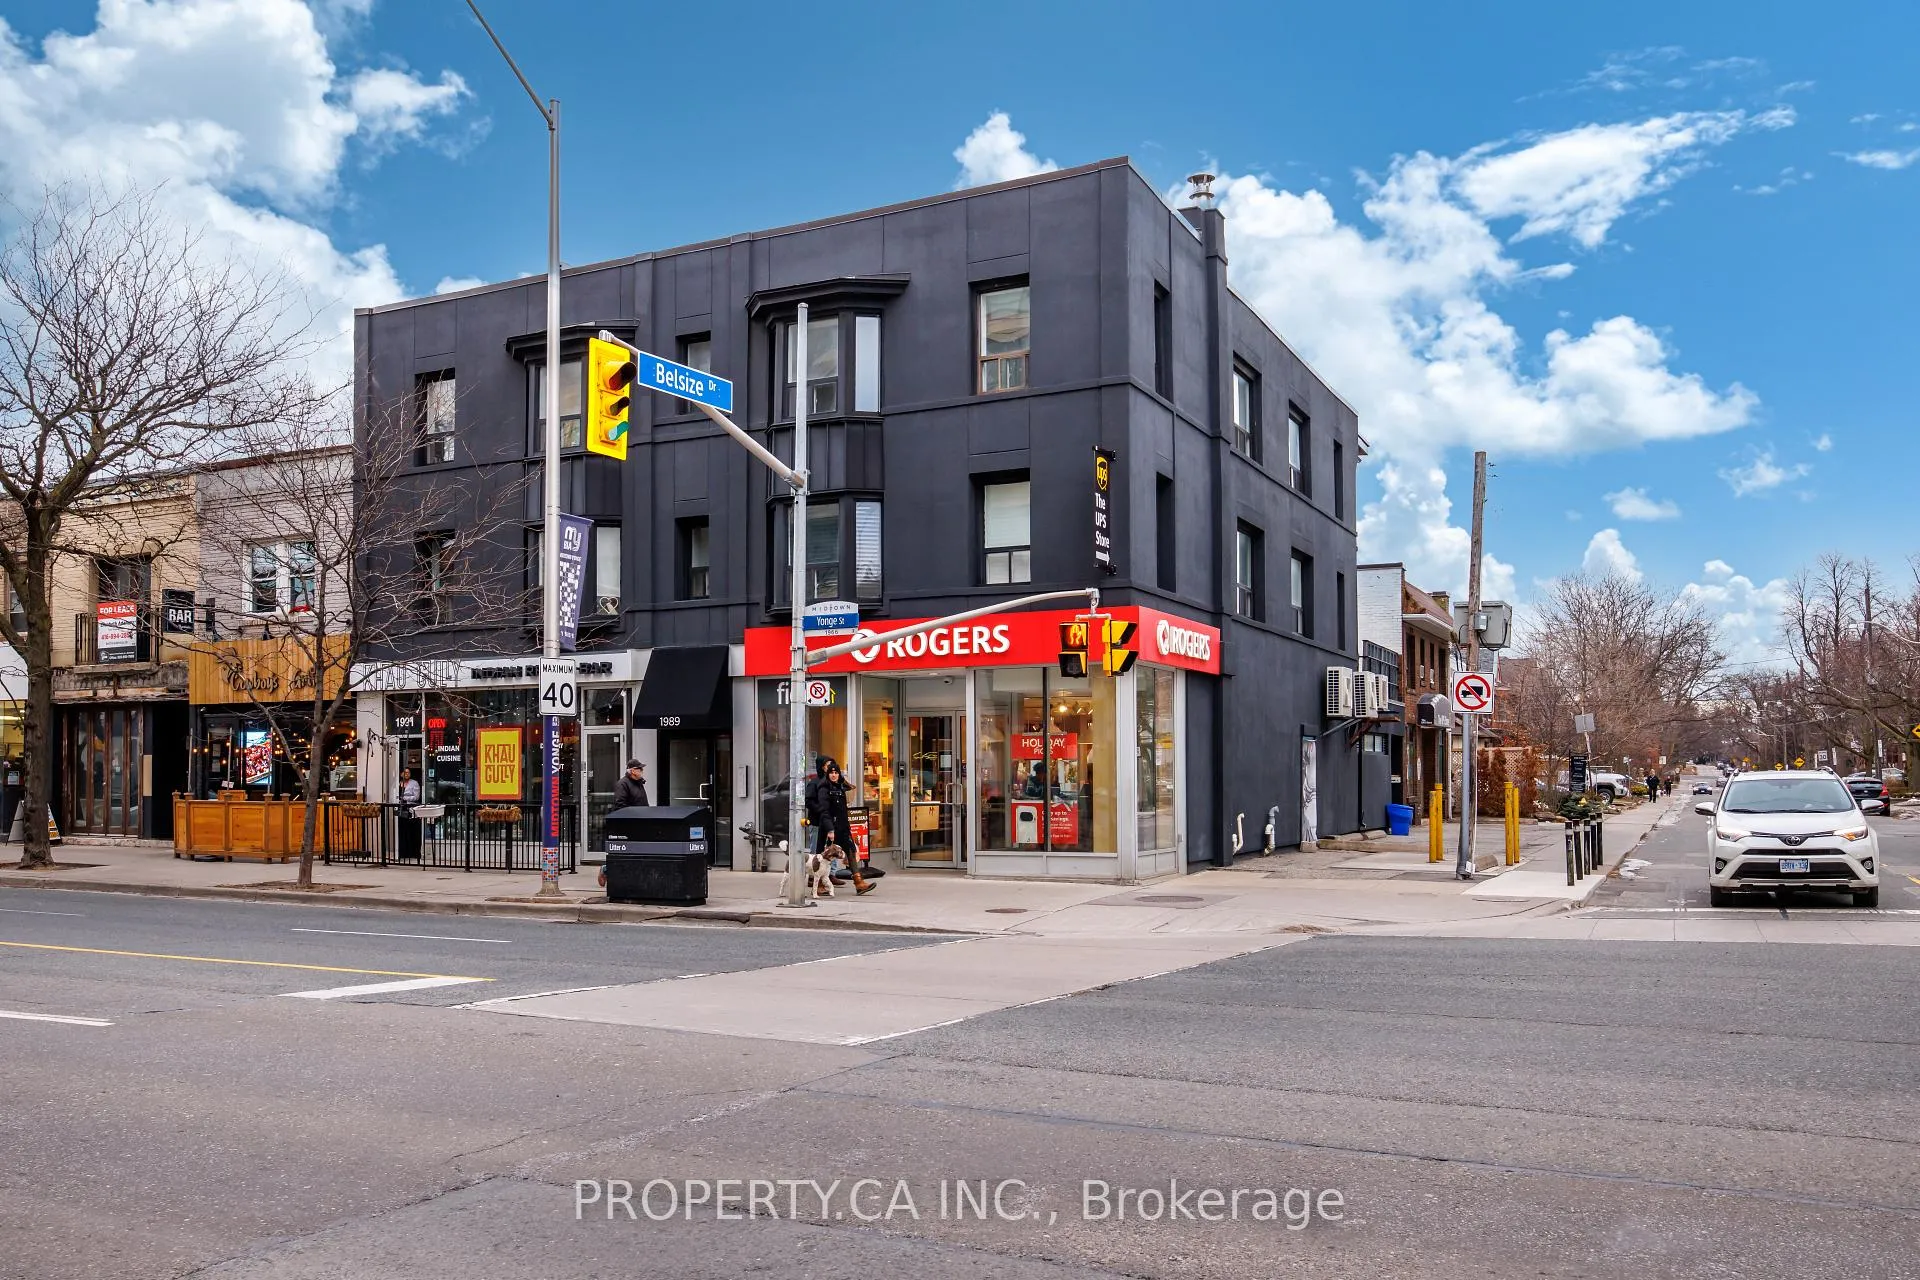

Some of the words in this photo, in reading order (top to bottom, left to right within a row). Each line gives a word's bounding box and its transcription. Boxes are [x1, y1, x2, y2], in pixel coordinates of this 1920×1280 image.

[656, 362, 704, 397] Belsize
[708, 380, 717, 391] Dr
[1095, 492, 1106, 510] The
[1095, 511, 1107, 529] UPS
[1095, 530, 1110, 549] Store
[99, 606, 113, 614] FOR
[168, 608, 192, 623] BAR
[812, 604, 851, 612] MIDTOWN
[816, 616, 838, 628] Yonge
[838, 617, 845, 625] St
[887, 624, 1011, 659] ROGERS
[1169, 625, 1211, 661] ROGERS
[363, 660, 407, 691] KHAU
[471, 665, 523, 679] INDIAN
[542, 663, 573, 674] MAXIMUM
[542, 682, 574, 708] 40
[428, 718, 447, 729] OPEN
[659, 716, 681, 727] 1989
[436, 754, 461, 762] CUISINE
[484, 743, 516, 763] KHAU
[551, 731, 560, 775] YONGE
[484, 764, 516, 784] GULLY
[551, 776, 559, 838] MIDTOWN
